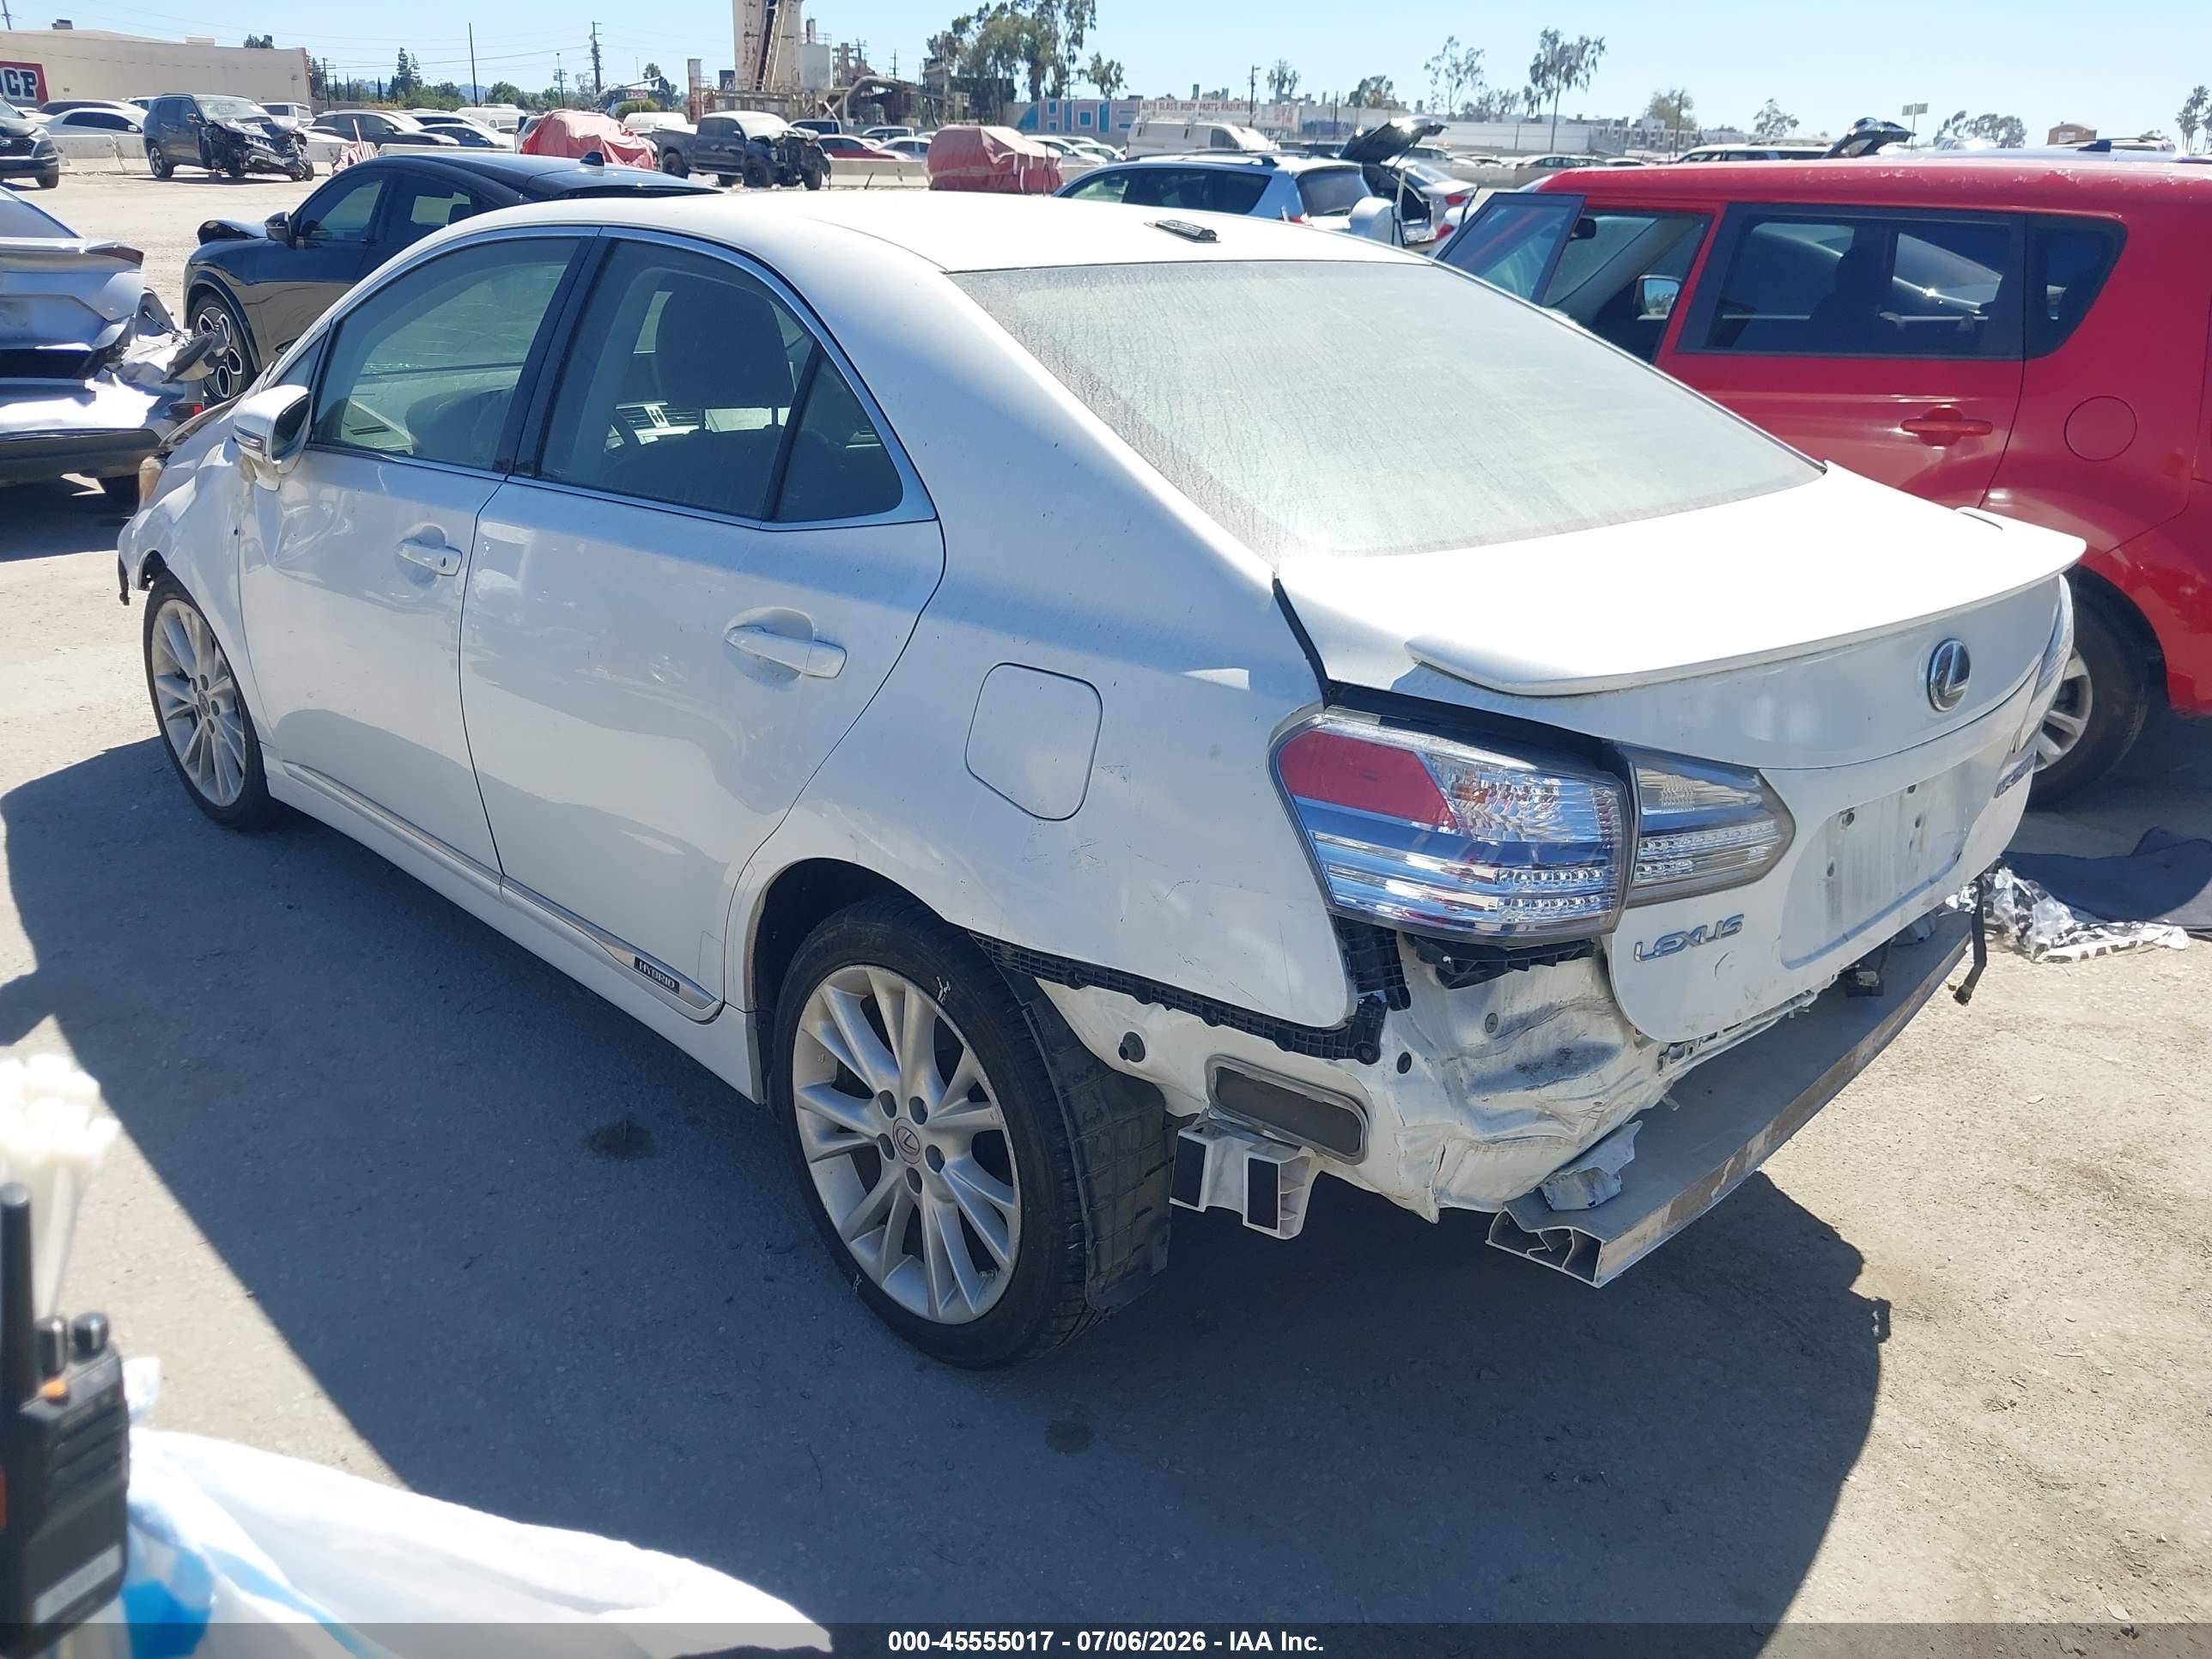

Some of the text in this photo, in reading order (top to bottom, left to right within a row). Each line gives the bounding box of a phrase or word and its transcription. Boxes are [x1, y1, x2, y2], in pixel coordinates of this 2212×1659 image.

[0, 68, 37, 99] CP
[1633, 913, 1745, 962] LEXUS
[639, 961, 675, 988] HYBRID
